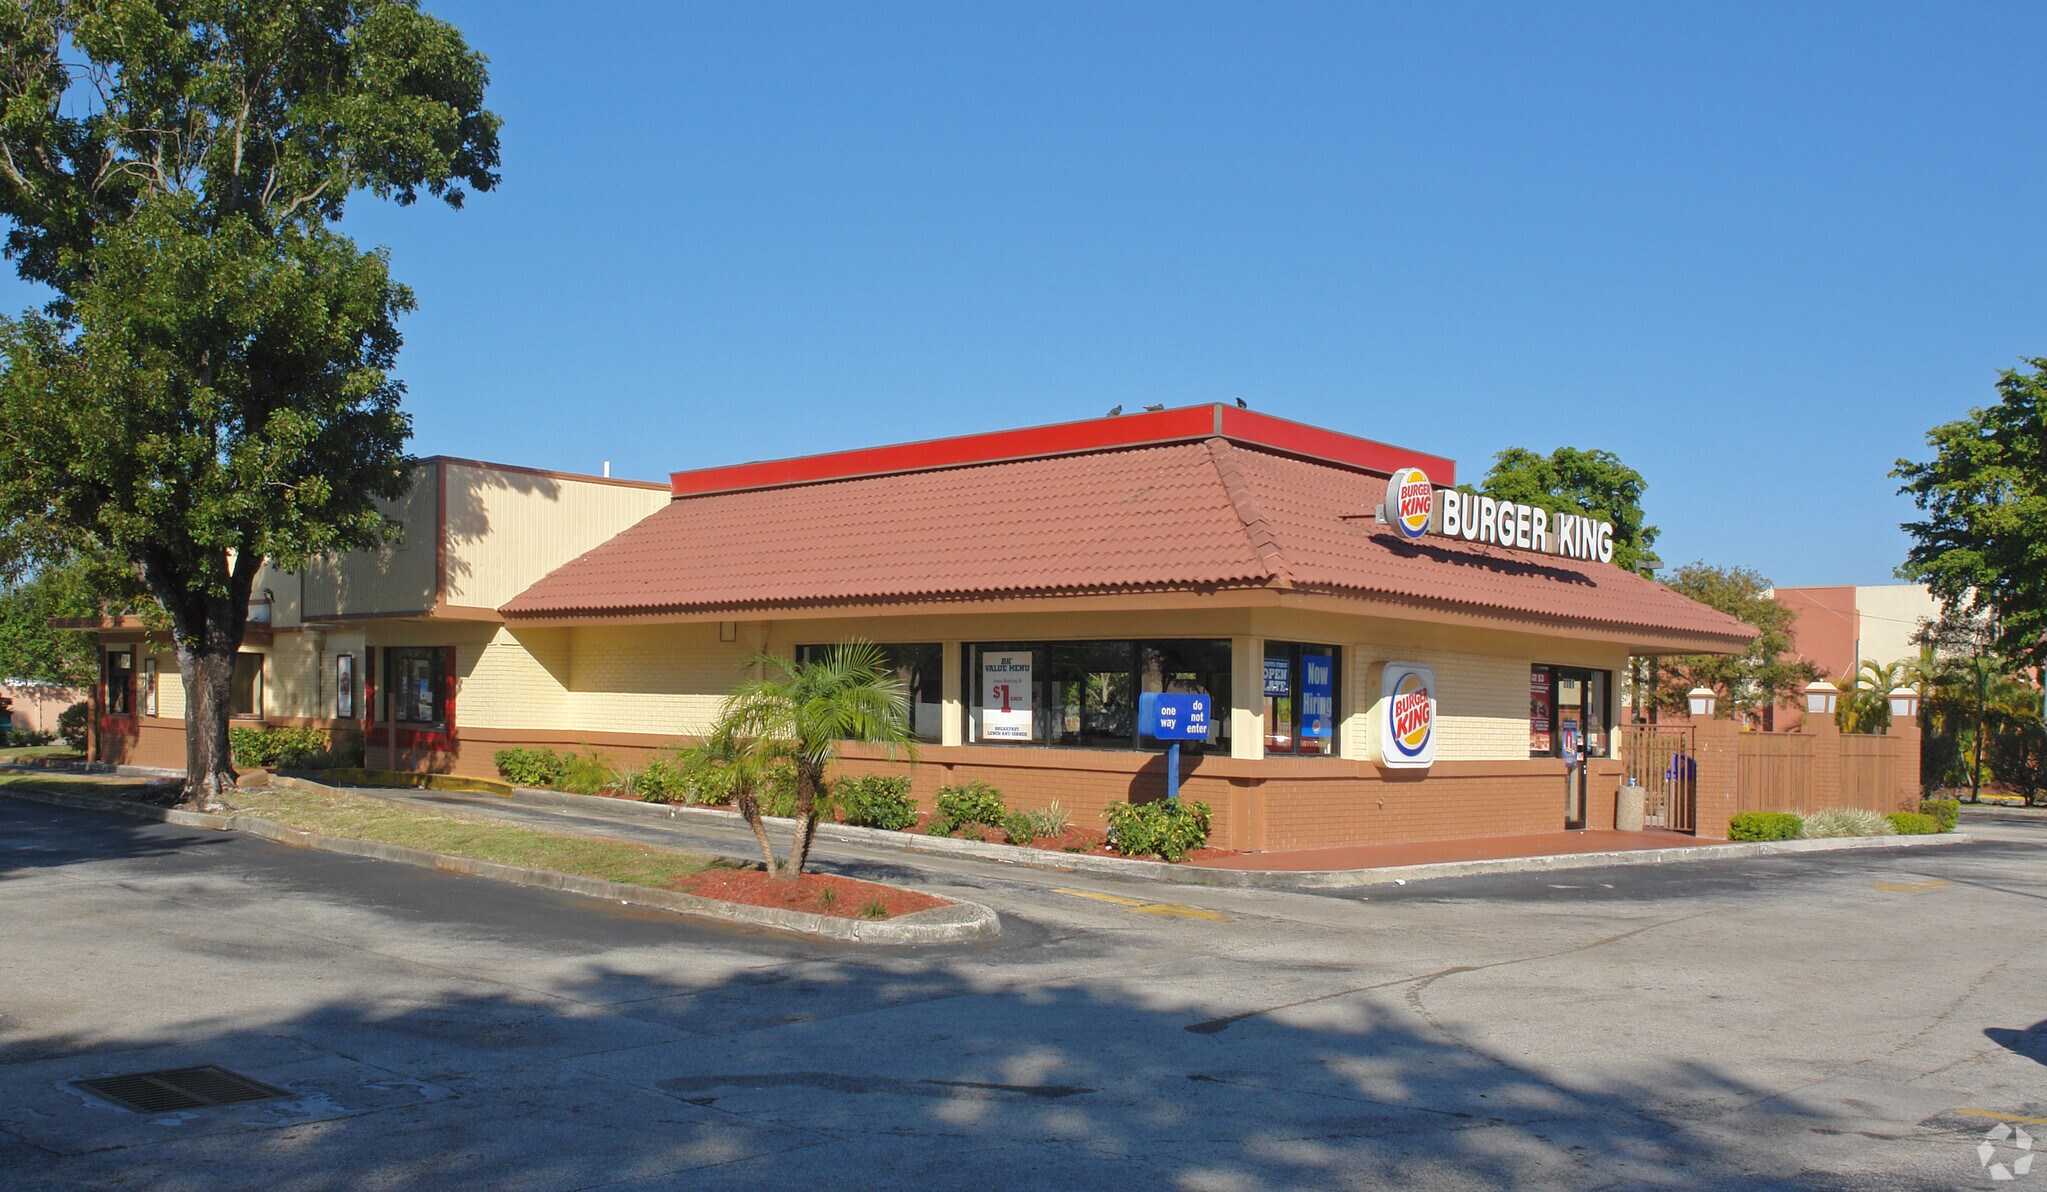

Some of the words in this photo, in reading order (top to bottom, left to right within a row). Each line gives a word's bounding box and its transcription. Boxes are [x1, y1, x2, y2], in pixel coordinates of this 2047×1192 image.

[1401, 483, 1431, 499] BURGER
[1400, 494, 1431, 517] KING
[1442, 489, 1547, 552] BURGER
[1558, 512, 1614, 563] KING
[1264, 668, 1287, 680] OPEN
[1307, 662, 1329, 685] Now
[1264, 680, 1287, 692] LATE
[1192, 700, 1203, 710] do
[1302, 692, 1332, 717] Hiring
[1396, 687, 1429, 717] BURGER
[1161, 707, 1176, 715] one
[1190, 712, 1204, 722] not
[1160, 719, 1176, 730] way
[1396, 702, 1430, 739] KING
[1186, 723, 1207, 733] enter
